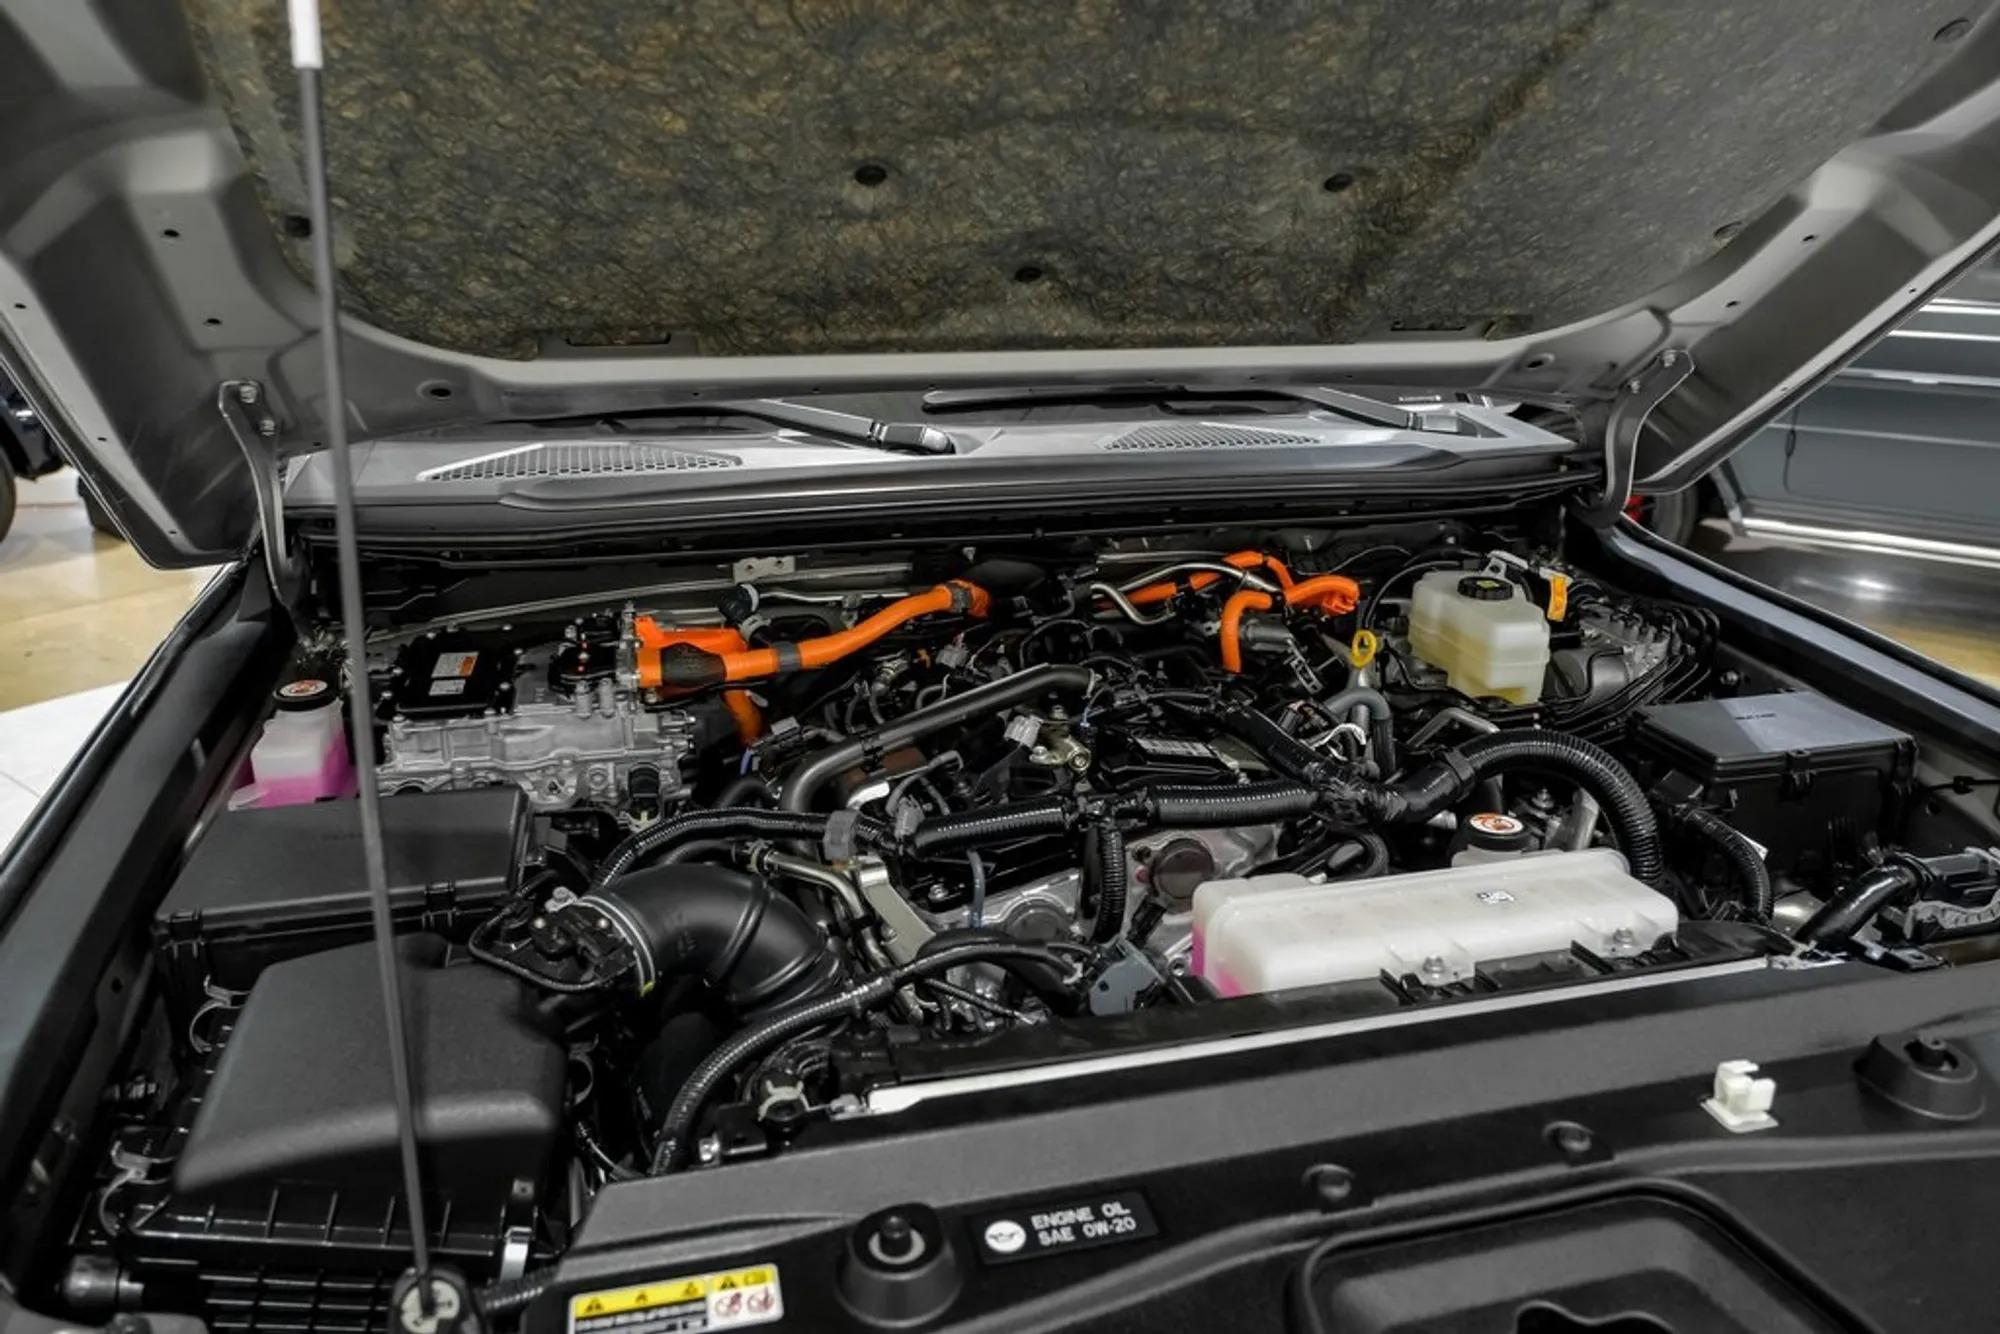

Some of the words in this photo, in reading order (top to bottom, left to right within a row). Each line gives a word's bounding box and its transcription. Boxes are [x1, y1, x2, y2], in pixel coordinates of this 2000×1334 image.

[1031, 1206, 1095, 1230] ENGINE
[1101, 1201, 1131, 1217] OIL
[1038, 1226, 1075, 1246] SAE
[1082, 1216, 1136, 1238] 0W-20
